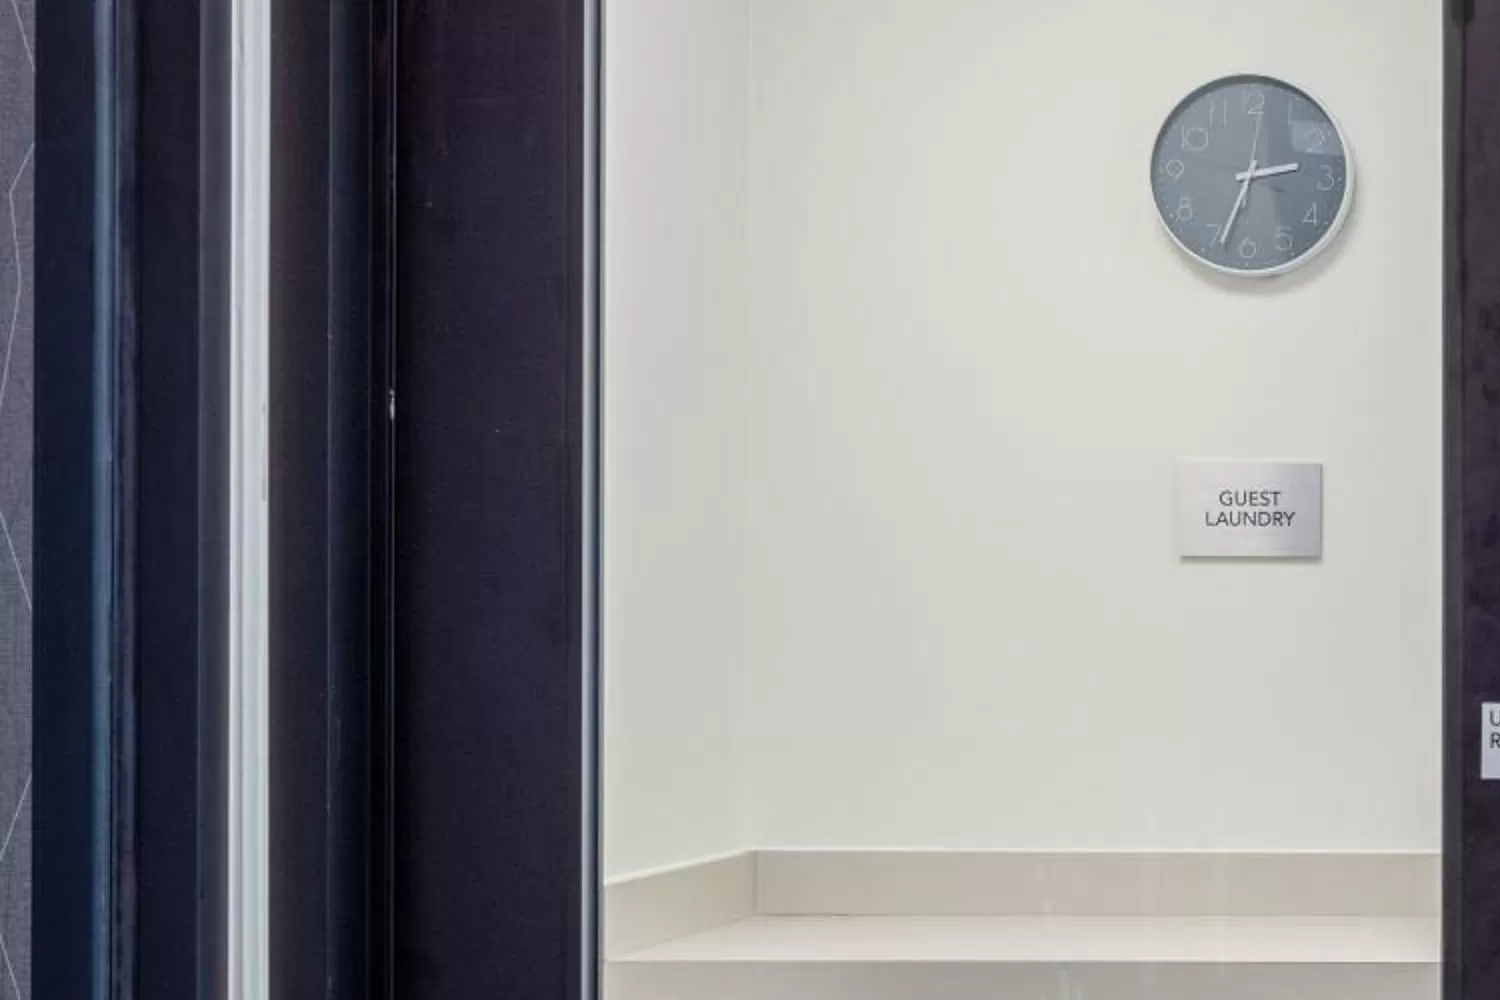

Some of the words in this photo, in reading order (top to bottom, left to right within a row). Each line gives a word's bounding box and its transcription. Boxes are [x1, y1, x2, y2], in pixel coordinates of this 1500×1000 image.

[1180, 125, 1209, 150] 10
[1316, 164, 1335, 191] 3
[1176, 196, 1193, 221] 8
[1302, 200, 1319, 226] 4
[1239, 236, 1257, 259] 6
[1275, 225, 1293, 251] 5
[1219, 489, 1281, 507] GUEST
[1205, 511, 1296, 527] LAUNDRY
